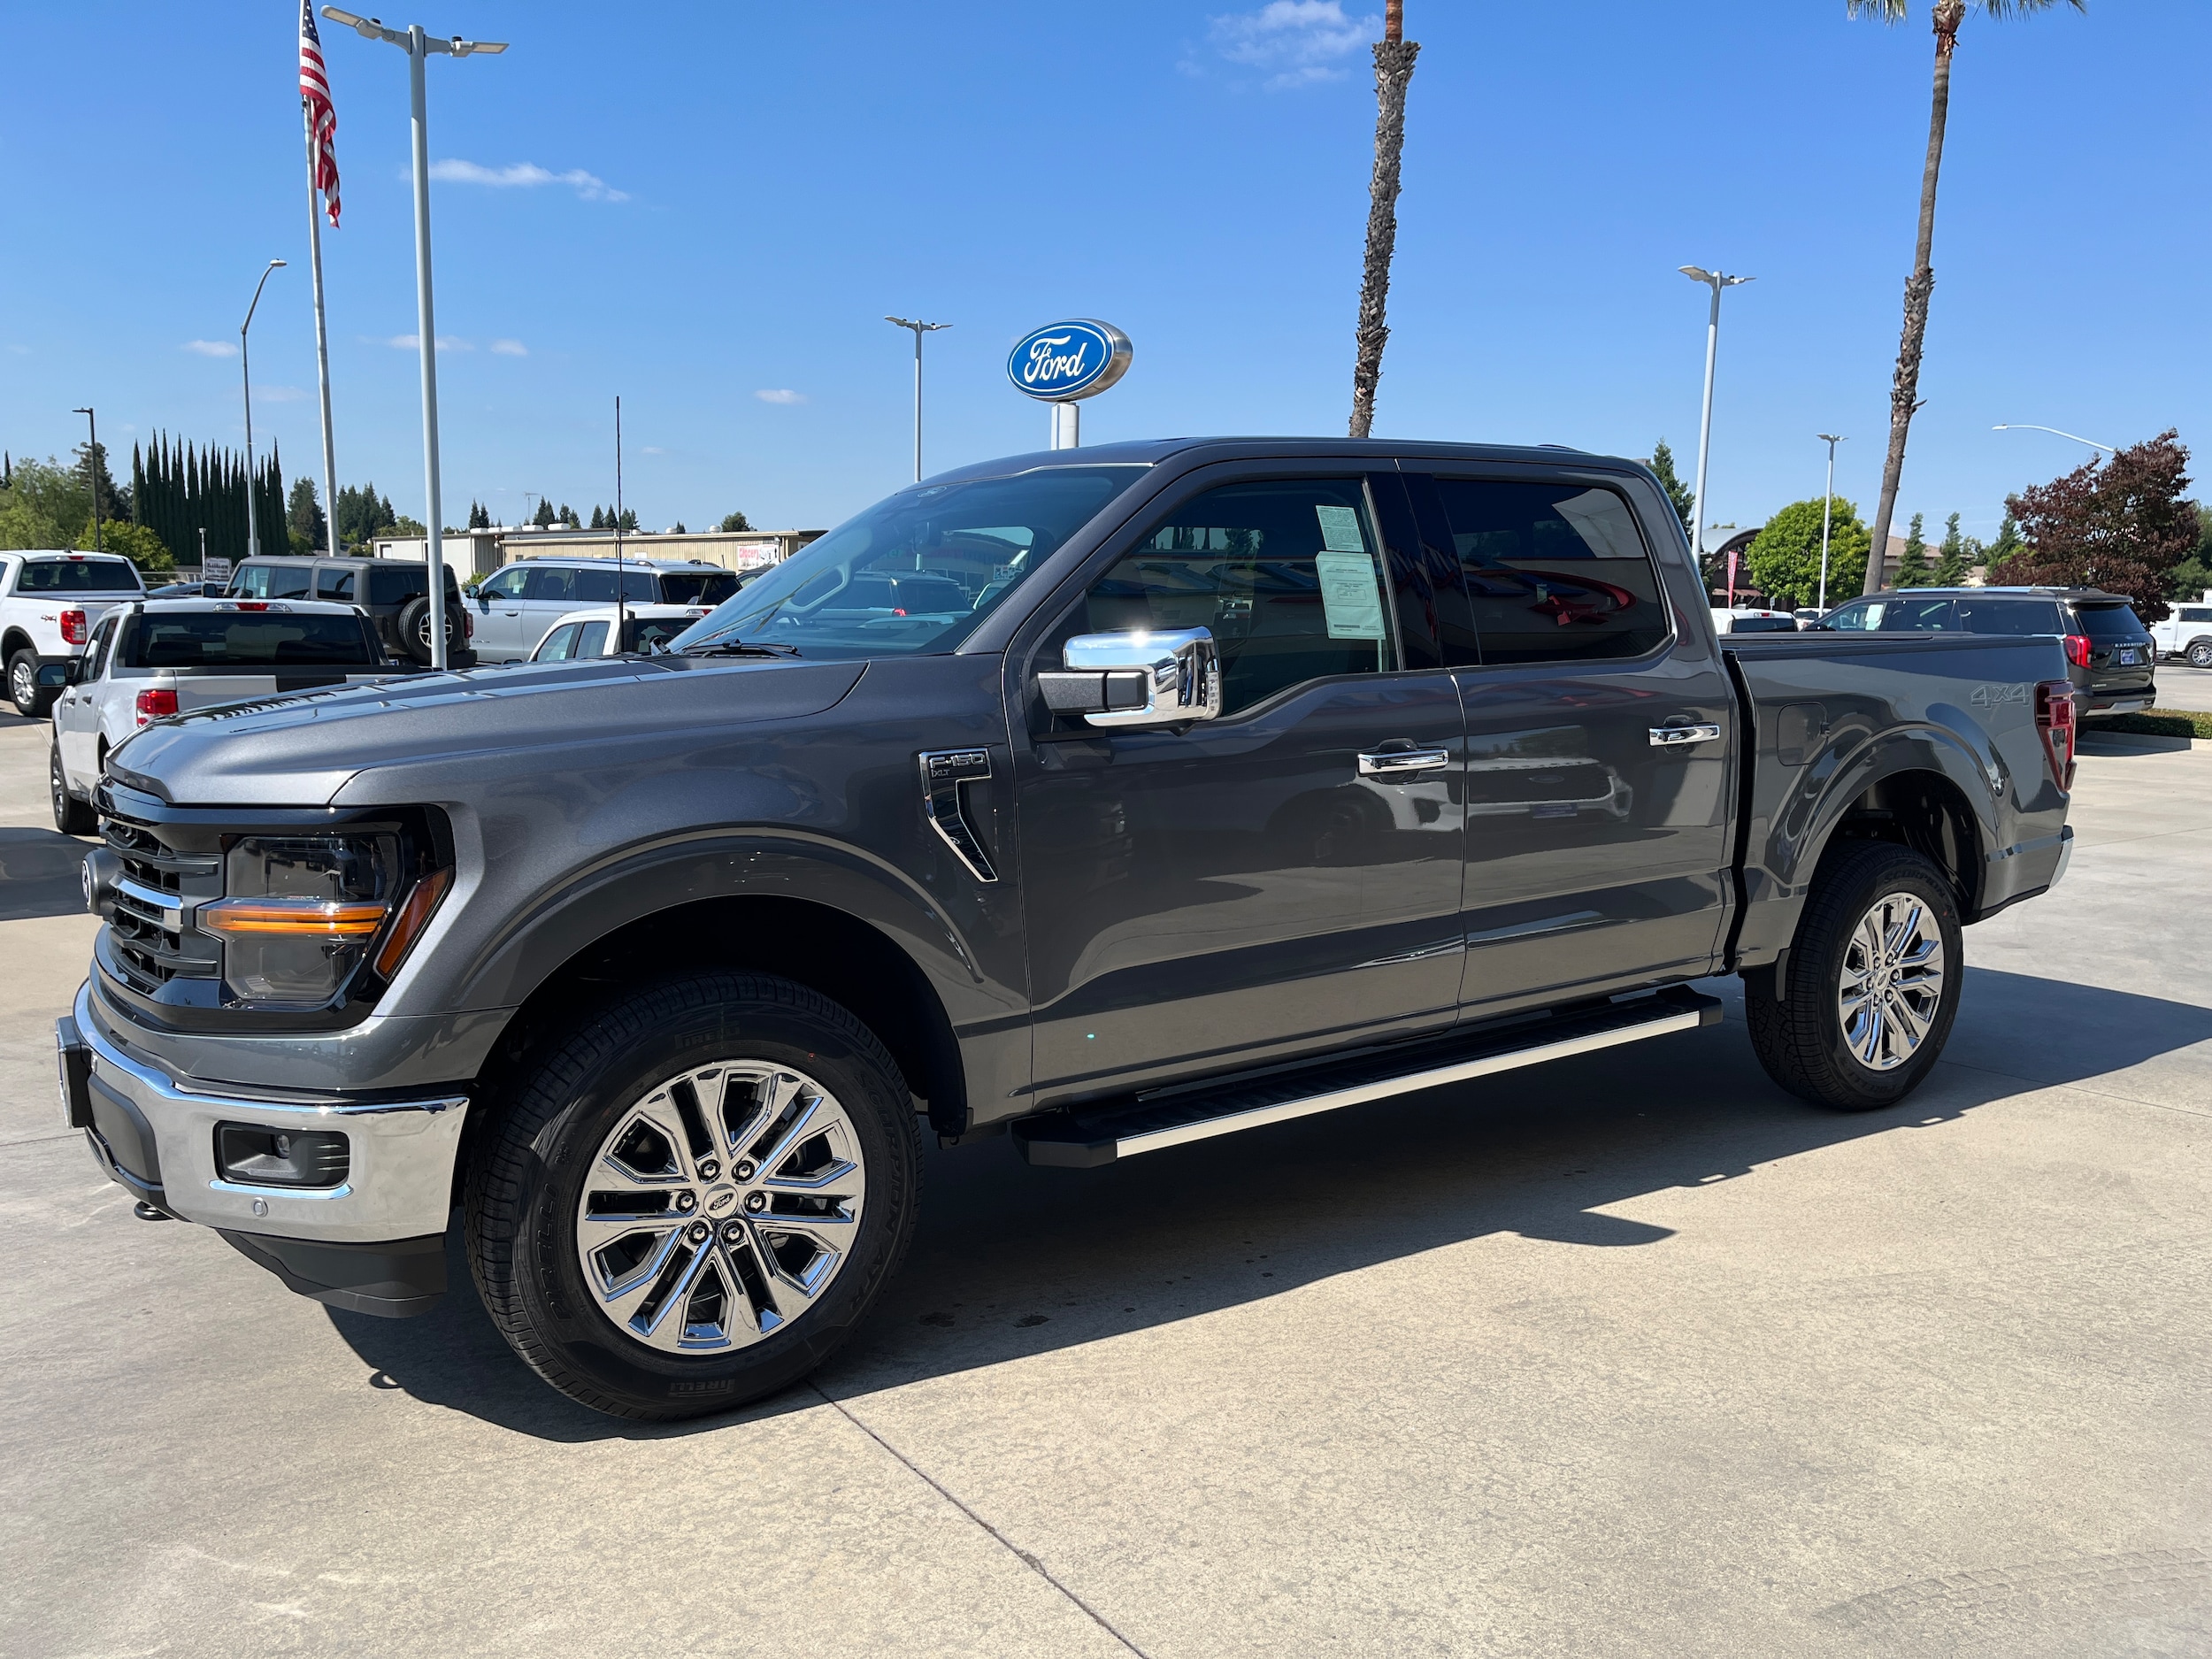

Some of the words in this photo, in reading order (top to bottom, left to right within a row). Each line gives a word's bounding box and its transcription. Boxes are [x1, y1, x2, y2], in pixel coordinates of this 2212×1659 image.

[1024, 335, 1088, 383] Ford
[929, 753, 986, 769] F-150
[855, 1073, 901, 1233] SCORPION
[537, 1182, 573, 1321] PIRELLI
[668, 1378, 736, 1398] PIRELLI
